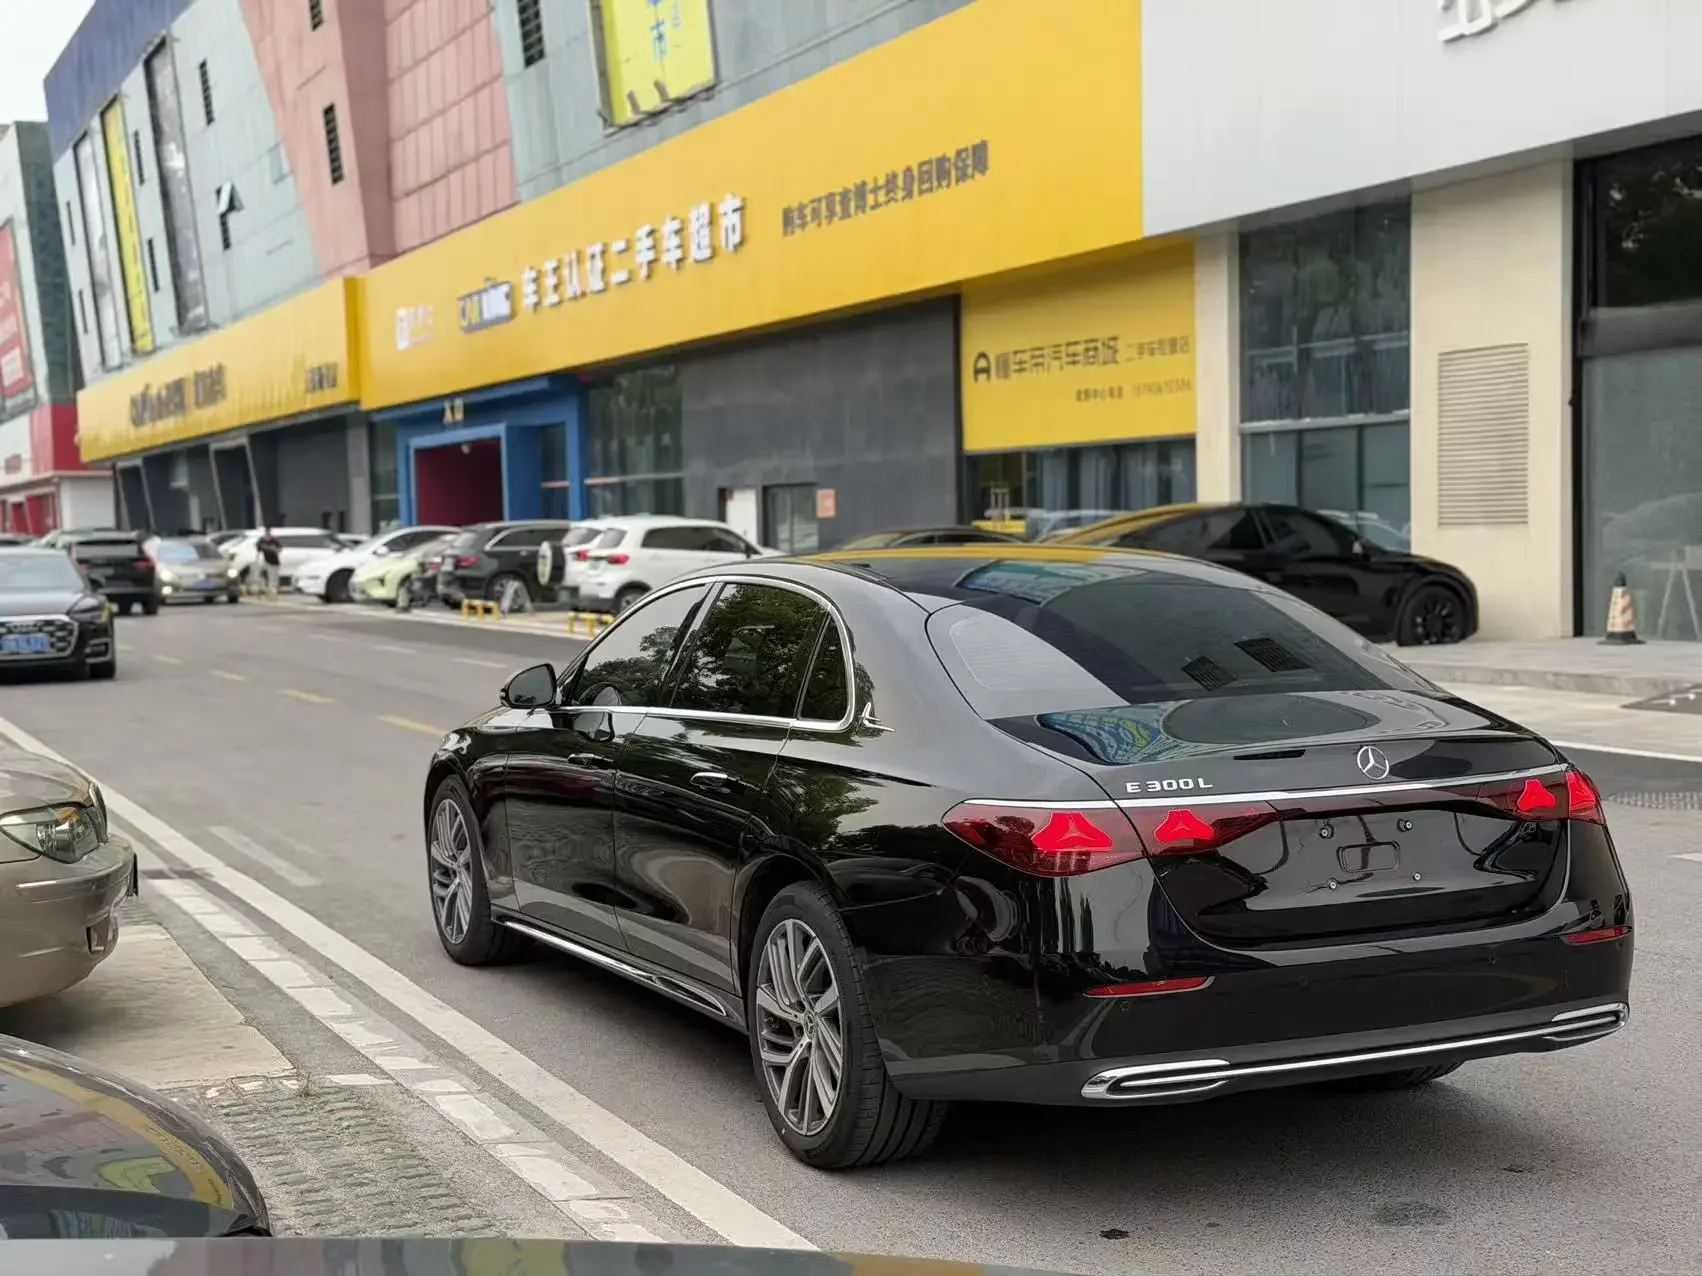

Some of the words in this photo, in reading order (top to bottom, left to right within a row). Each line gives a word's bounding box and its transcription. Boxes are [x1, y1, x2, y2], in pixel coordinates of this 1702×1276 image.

[521, 192, 747, 314] 车王认证二手车超市
